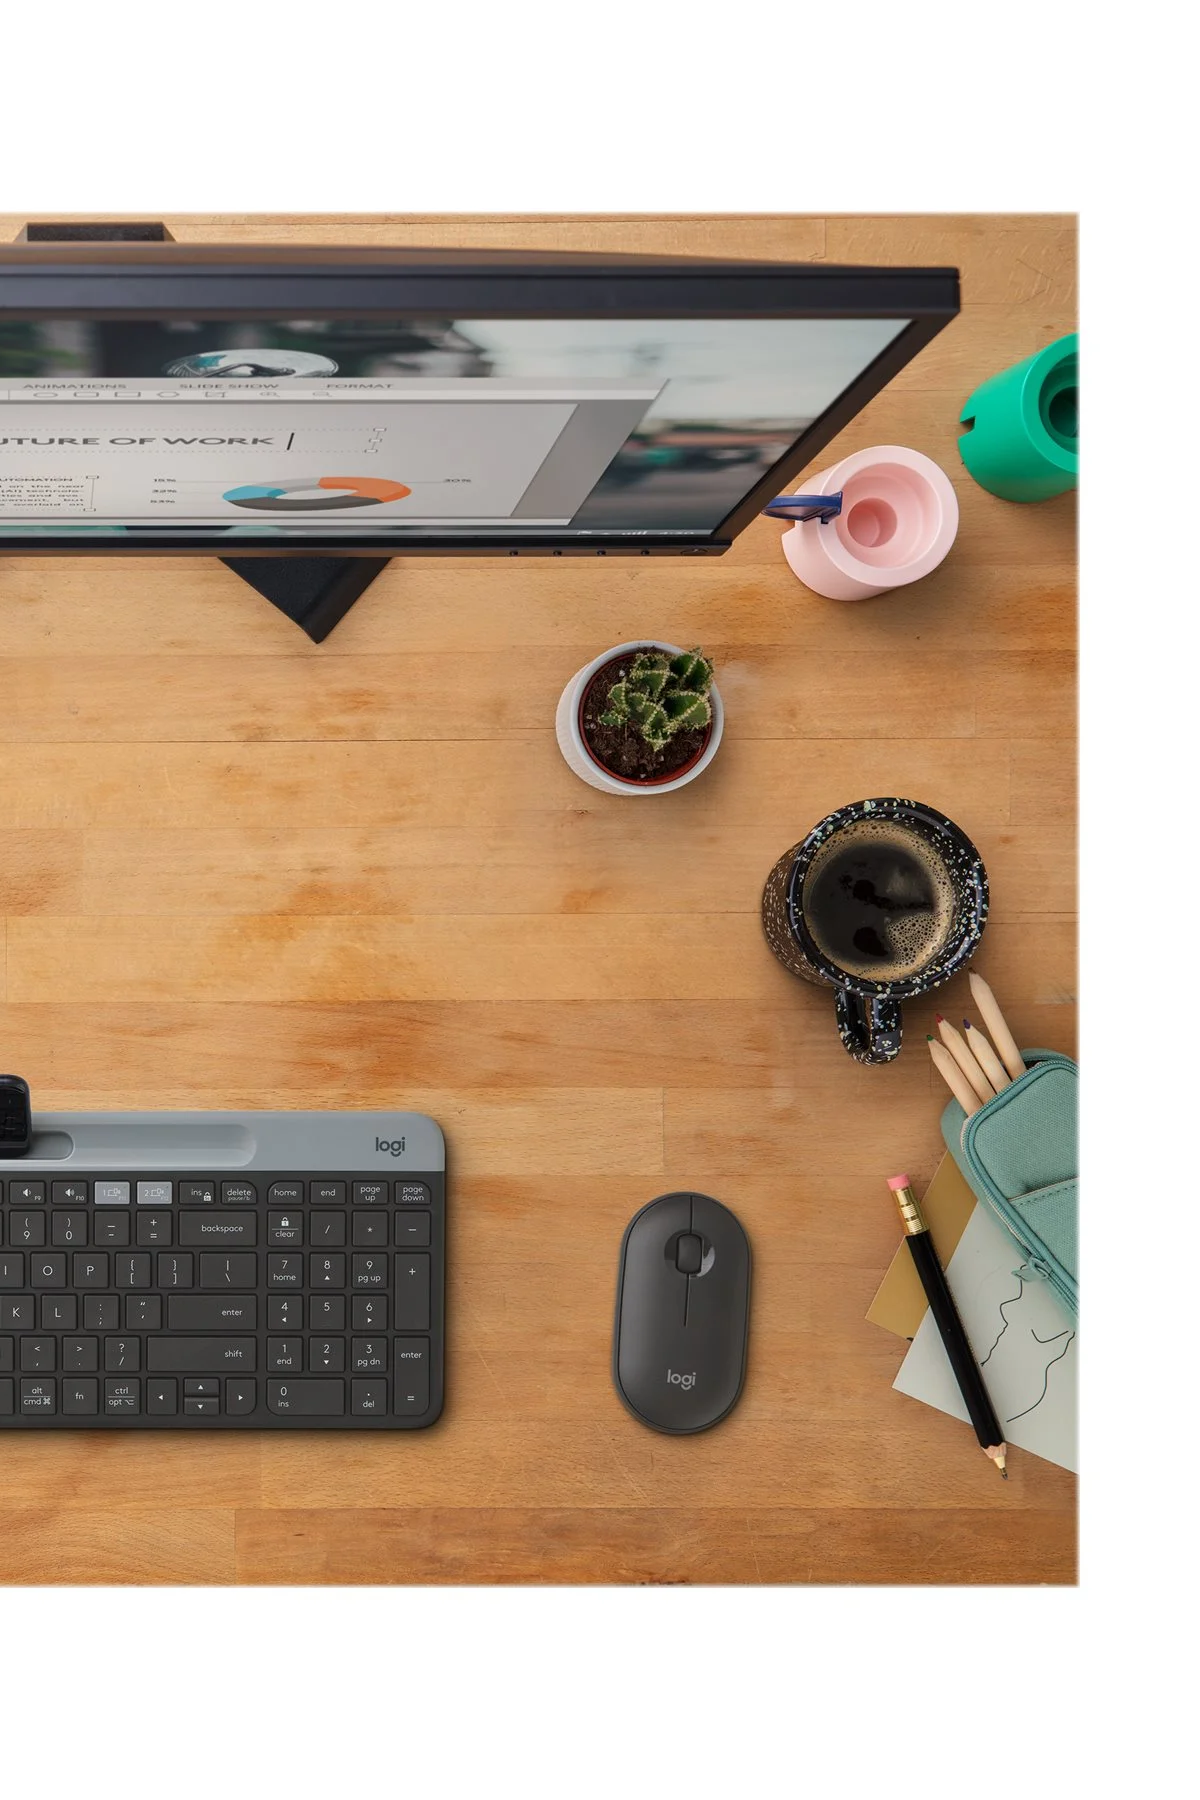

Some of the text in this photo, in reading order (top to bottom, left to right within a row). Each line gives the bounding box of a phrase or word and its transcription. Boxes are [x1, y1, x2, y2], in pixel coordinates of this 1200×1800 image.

[109, 437, 156, 445] OF
[162, 437, 274, 445] WORK
[375, 1137, 406, 1157] logi
[227, 1189, 251, 1197] delete
[403, 1187, 423, 1195] page
[402, 1193, 424, 1201] down
[202, 1225, 243, 1233] backspace
[276, 1229, 296, 1237] clear
[23, 1231, 31, 1239] 9
[65, 1231, 73, 1240] 0
[281, 1260, 288, 1269] 7
[323, 1261, 331, 1269] 8
[366, 1261, 374, 1269] 9
[42, 1266, 53, 1275] O
[86, 1266, 95, 1275] P
[323, 1302, 331, 1311] 5
[365, 1303, 373, 1311] 6
[12, 1308, 21, 1317] K
[54, 1308, 62, 1317] L
[323, 1344, 330, 1353] 2
[366, 1345, 373, 1353] 3
[667, 1369, 696, 1390] logi
[280, 1387, 288, 1396] 0
[108, 1398, 122, 1406] opt
